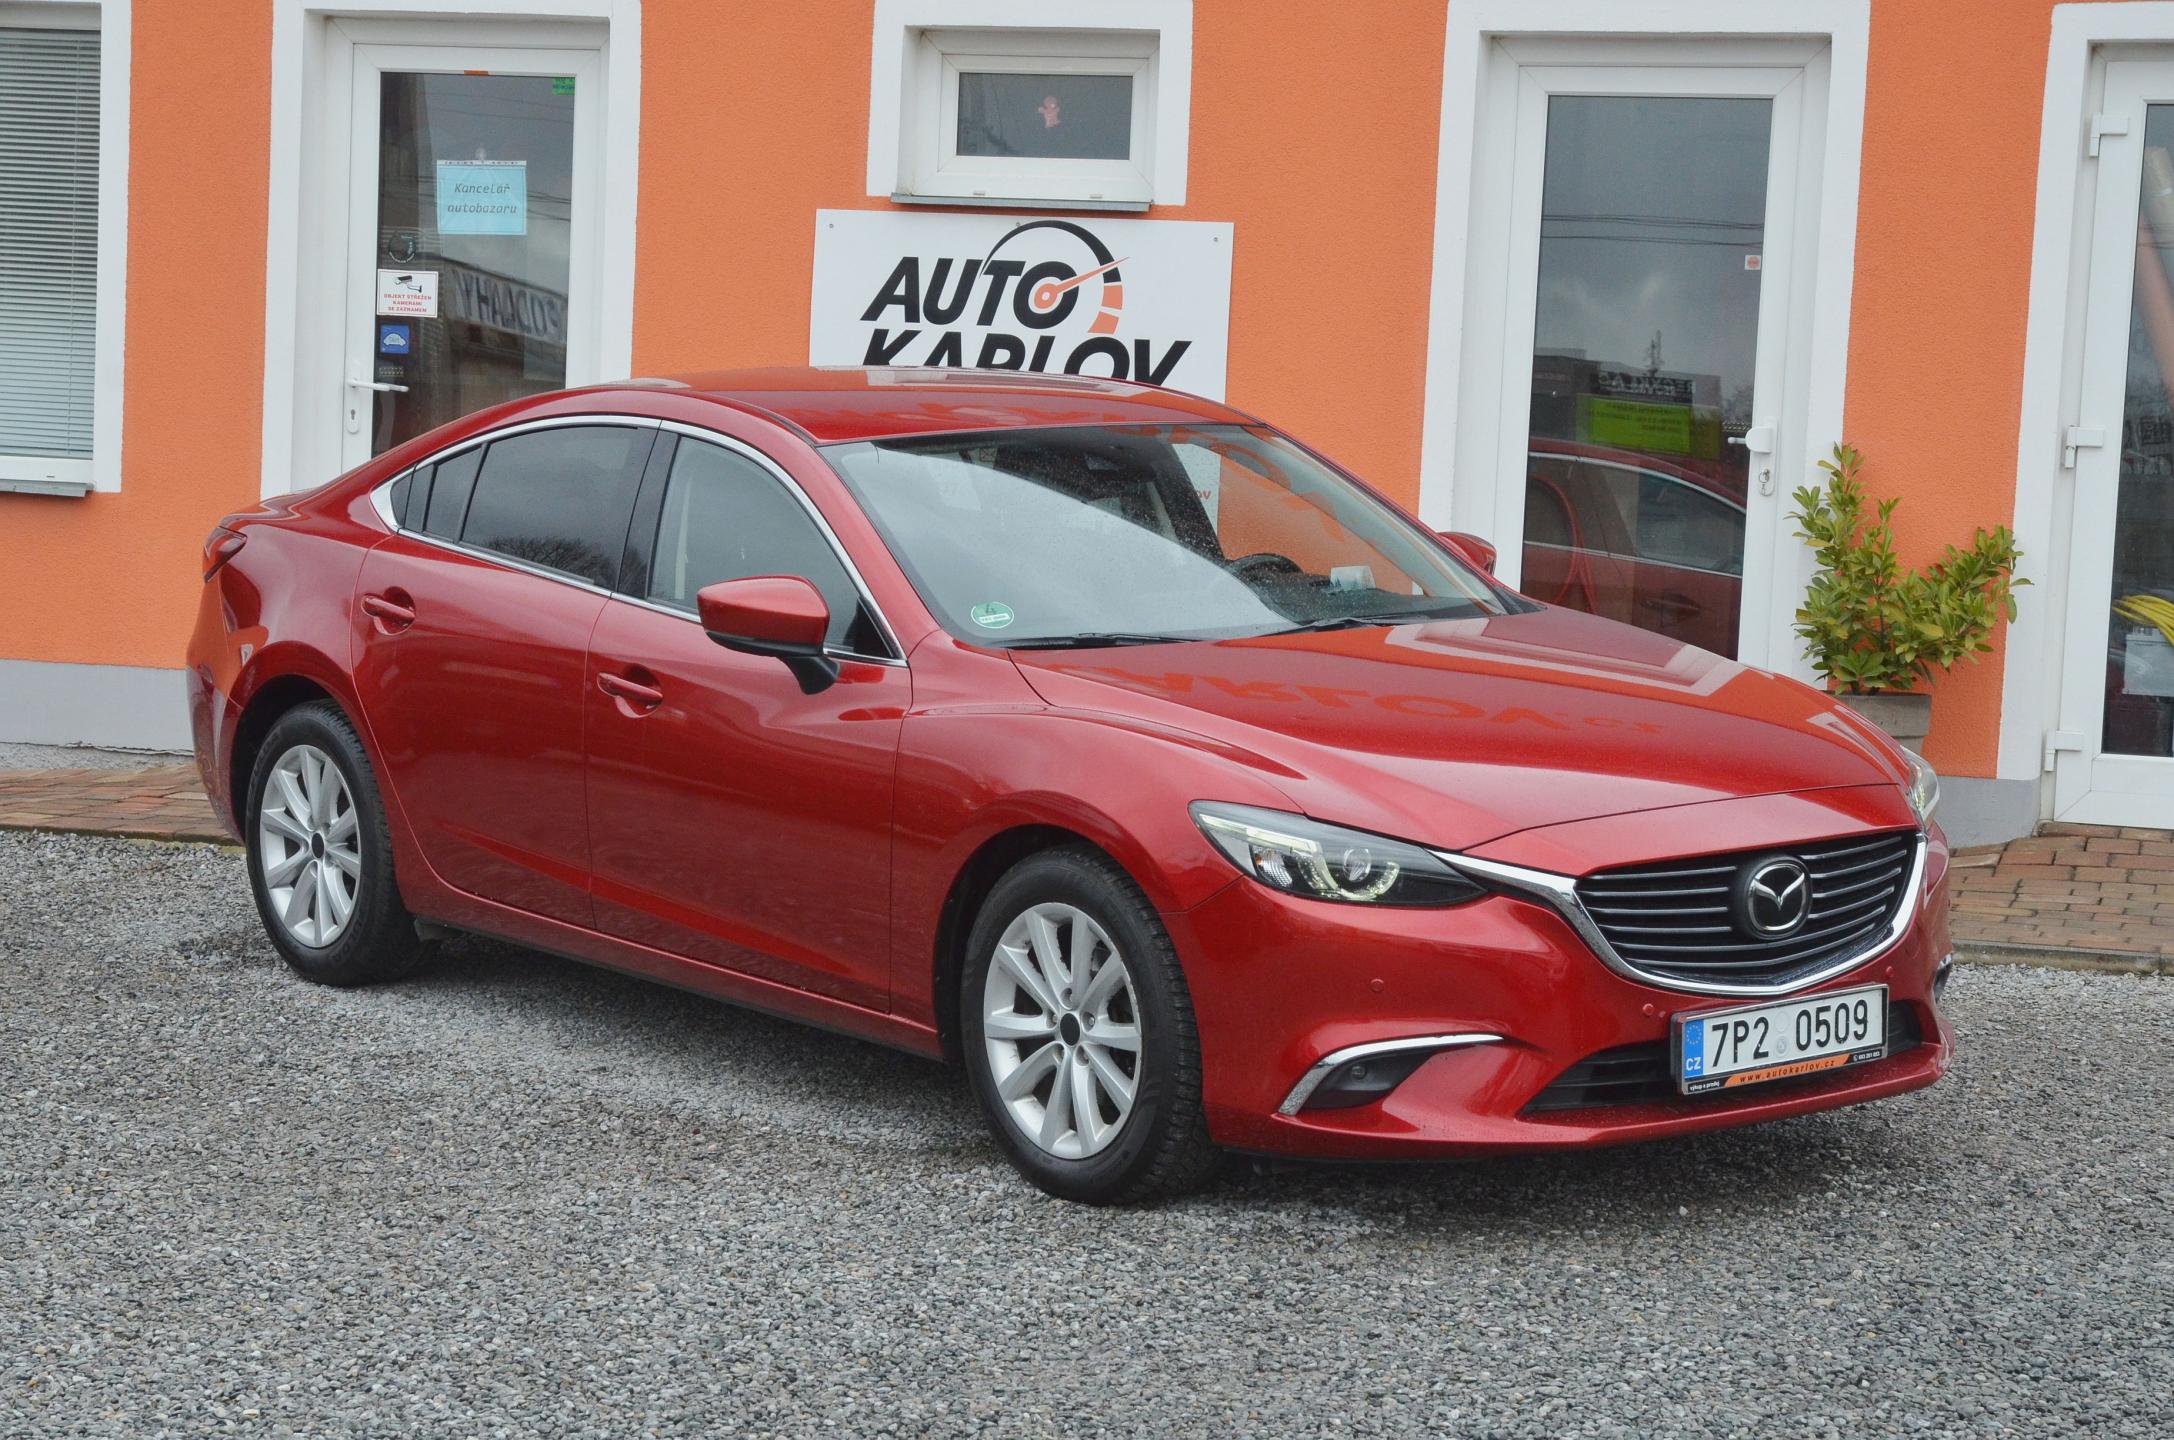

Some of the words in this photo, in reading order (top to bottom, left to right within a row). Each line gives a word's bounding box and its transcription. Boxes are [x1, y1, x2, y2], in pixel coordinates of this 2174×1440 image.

[454, 183, 511, 194] Kancelář
[447, 203, 517, 214] autobazaru
[859, 256, 1080, 330] AUTO
[1711, 1016, 1770, 1068] 7P2
[1795, 999, 1868, 1052] 0509
[1685, 1056, 1702, 1071] CZ
[1739, 1060, 1836, 1083] www.autokarlov.cz
